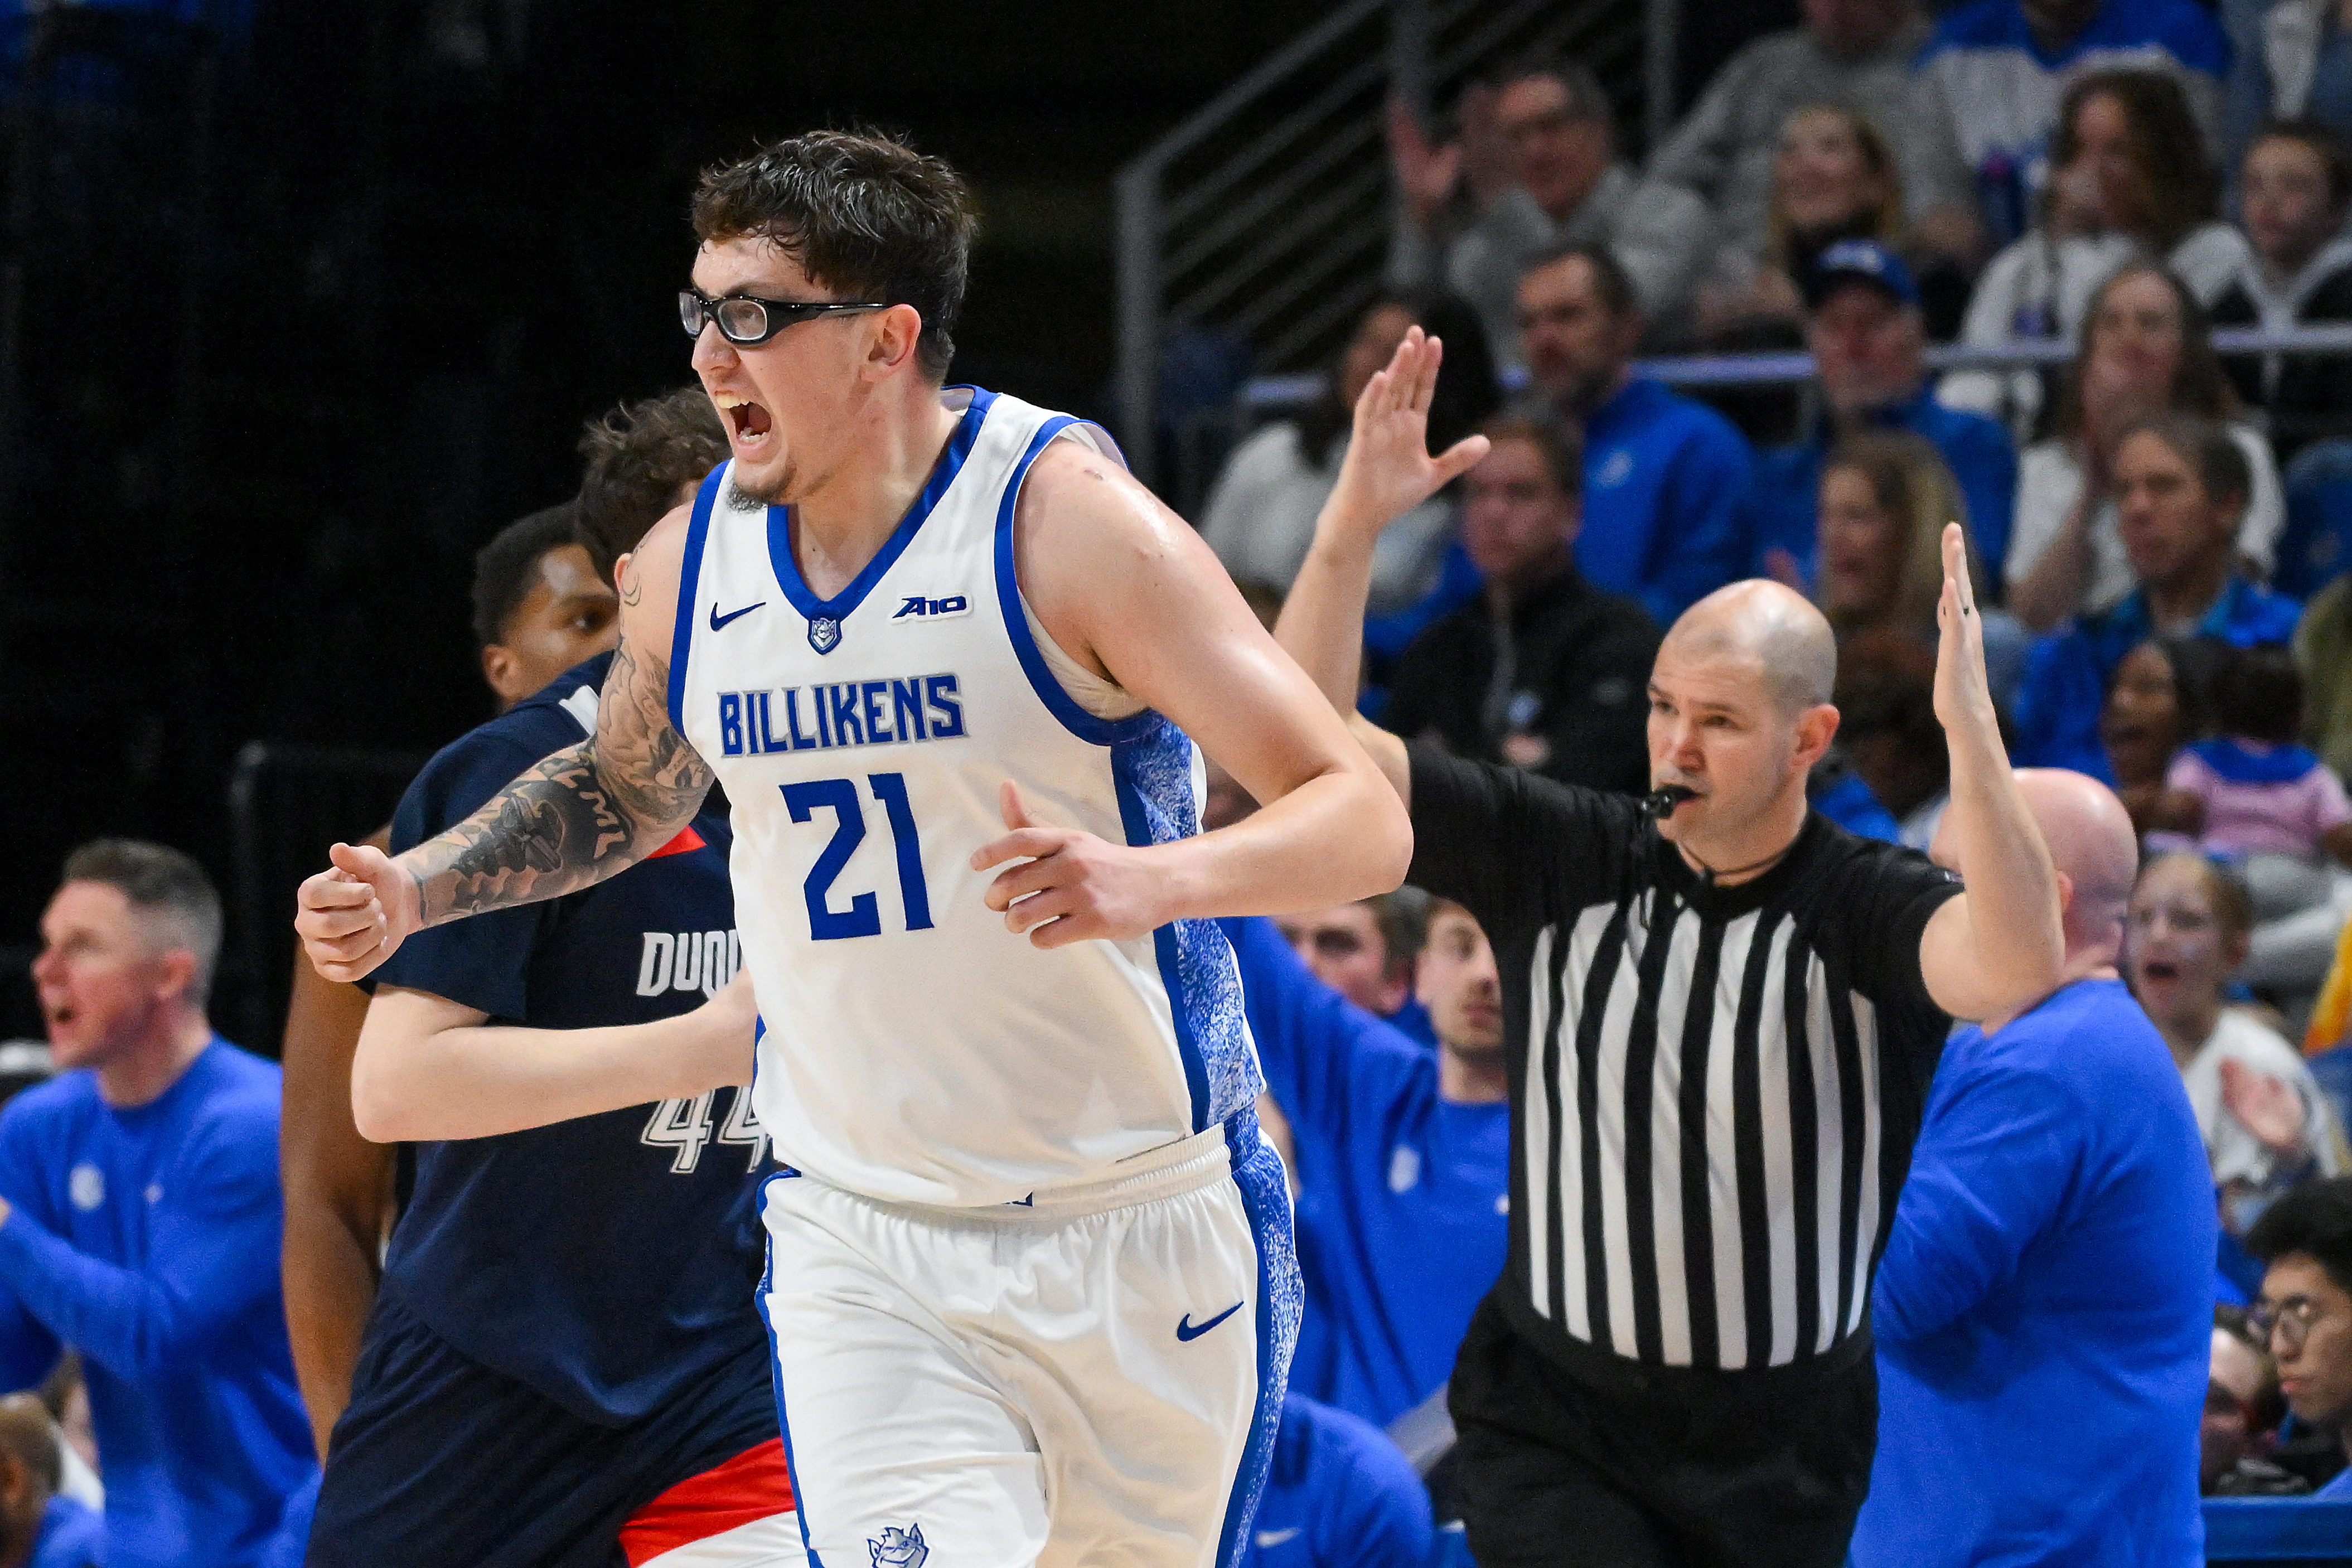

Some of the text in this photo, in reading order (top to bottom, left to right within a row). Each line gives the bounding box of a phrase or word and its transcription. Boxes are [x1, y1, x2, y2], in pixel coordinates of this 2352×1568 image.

[892, 596, 967, 618] A10
[717, 672, 969, 758] BILLIKENS
[778, 773, 935, 941] 21
